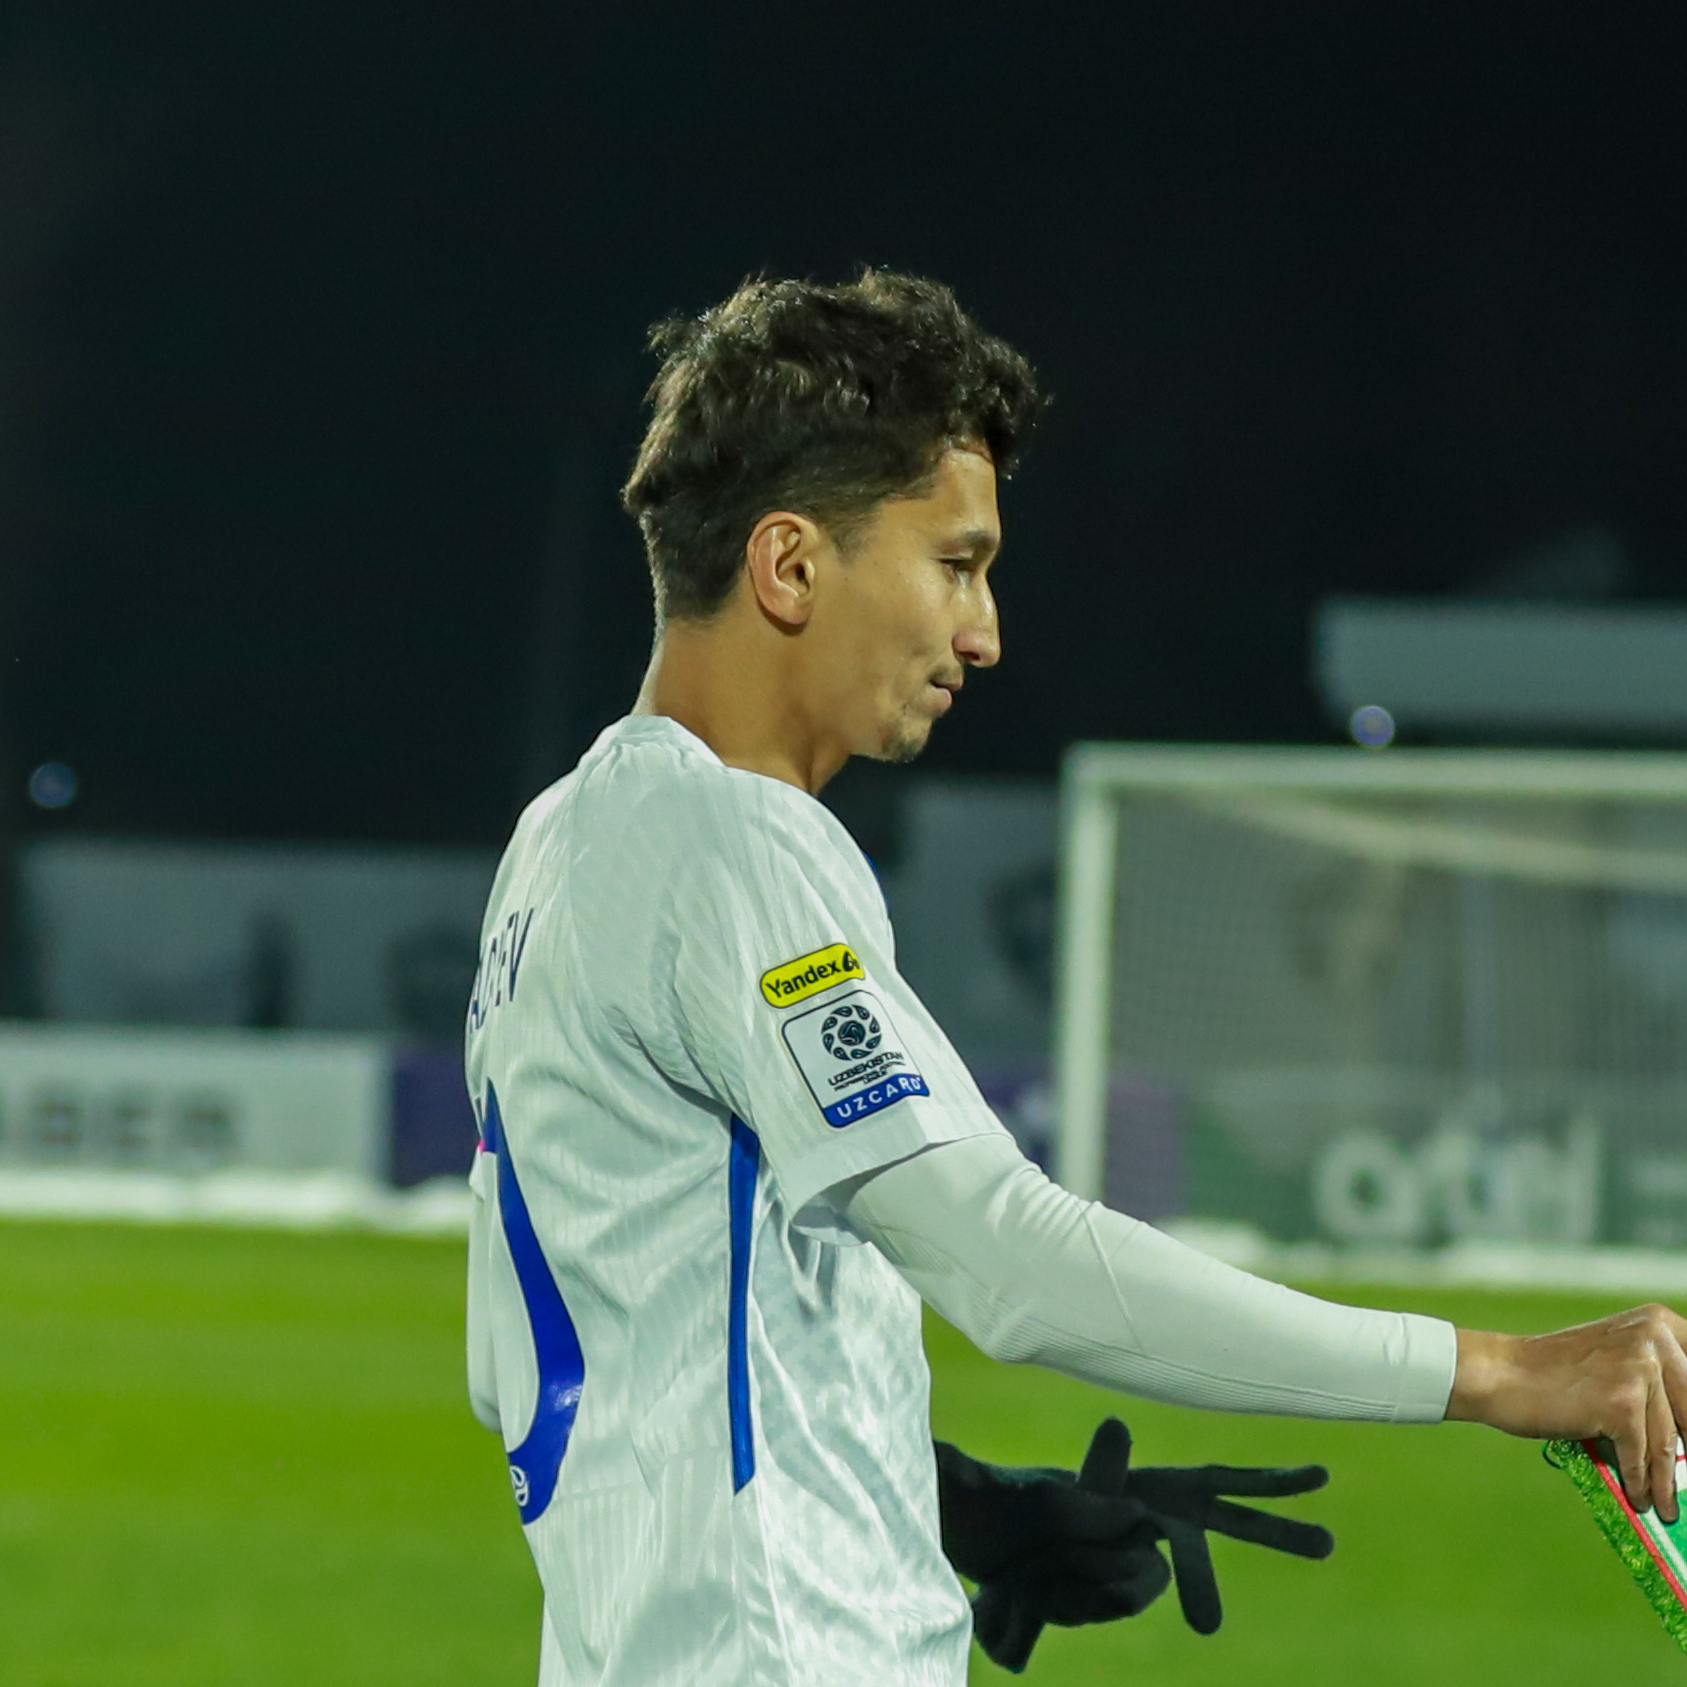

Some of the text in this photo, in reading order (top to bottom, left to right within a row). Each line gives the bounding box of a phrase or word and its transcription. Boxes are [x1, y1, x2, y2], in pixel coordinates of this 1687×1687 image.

[765, 959, 841, 998] Yandex
[827, 1052, 904, 1086] UZBEKISTAN
[836, 1077, 922, 1118] UZCARD
